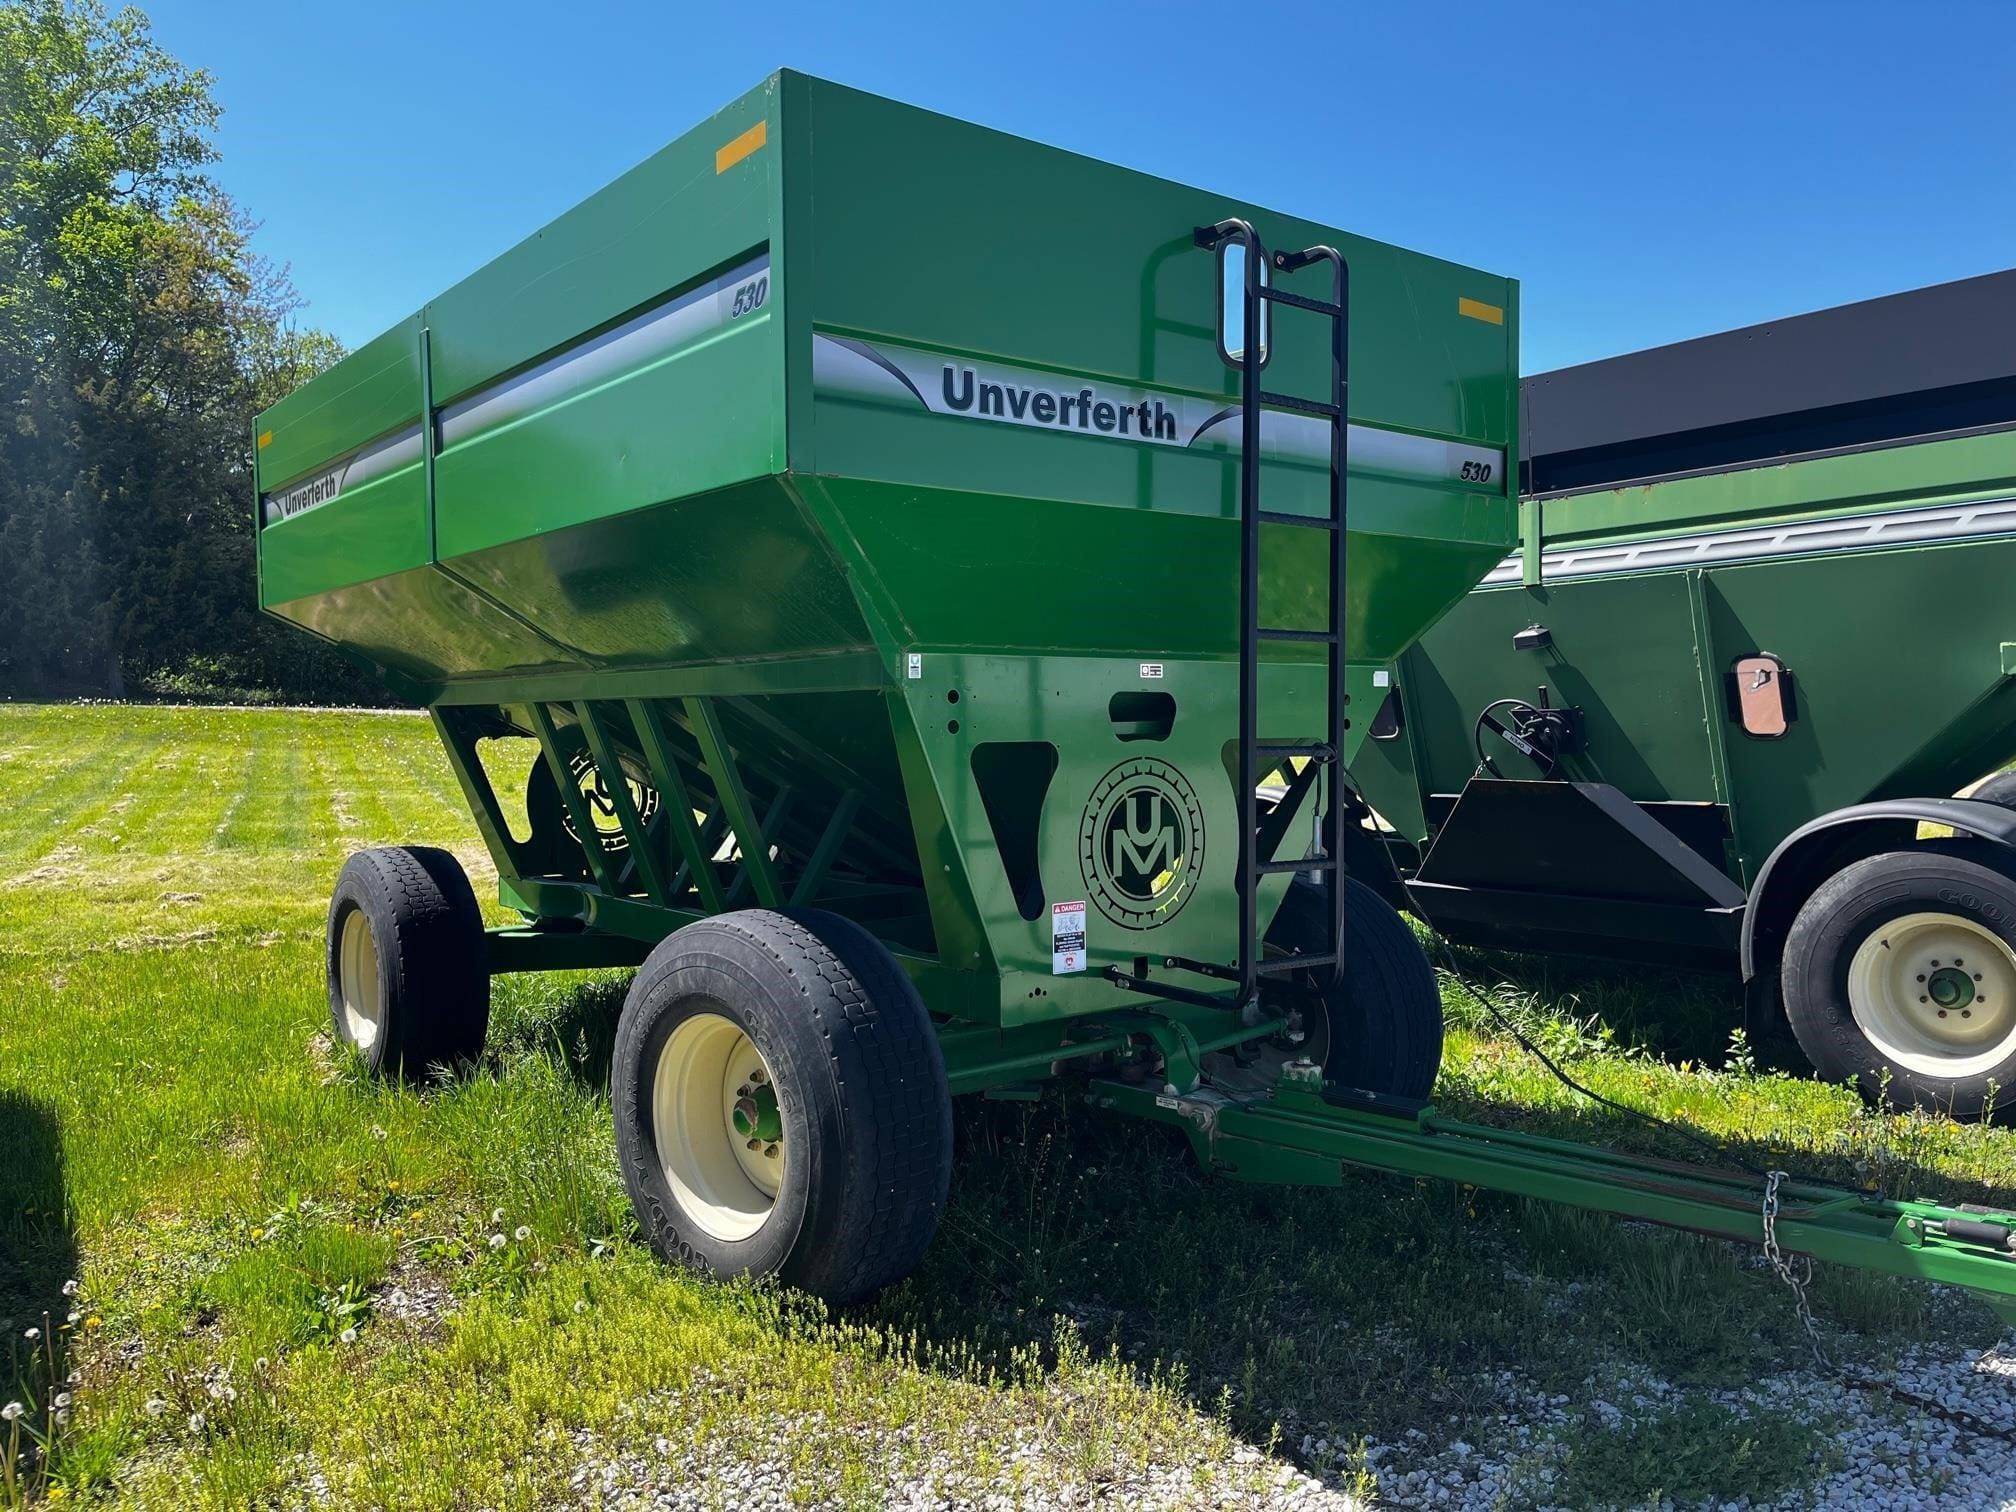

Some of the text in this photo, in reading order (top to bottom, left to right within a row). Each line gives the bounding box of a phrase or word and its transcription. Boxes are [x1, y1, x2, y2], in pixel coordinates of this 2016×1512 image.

[732, 276, 768, 319] 530
[942, 366, 1178, 442] Unverferth
[1460, 460, 1492, 484] 530
[285, 473, 336, 516] Unverferth
[1061, 903, 1084, 913] DANGER
[625, 1079, 713, 1276] GOODYEAR
